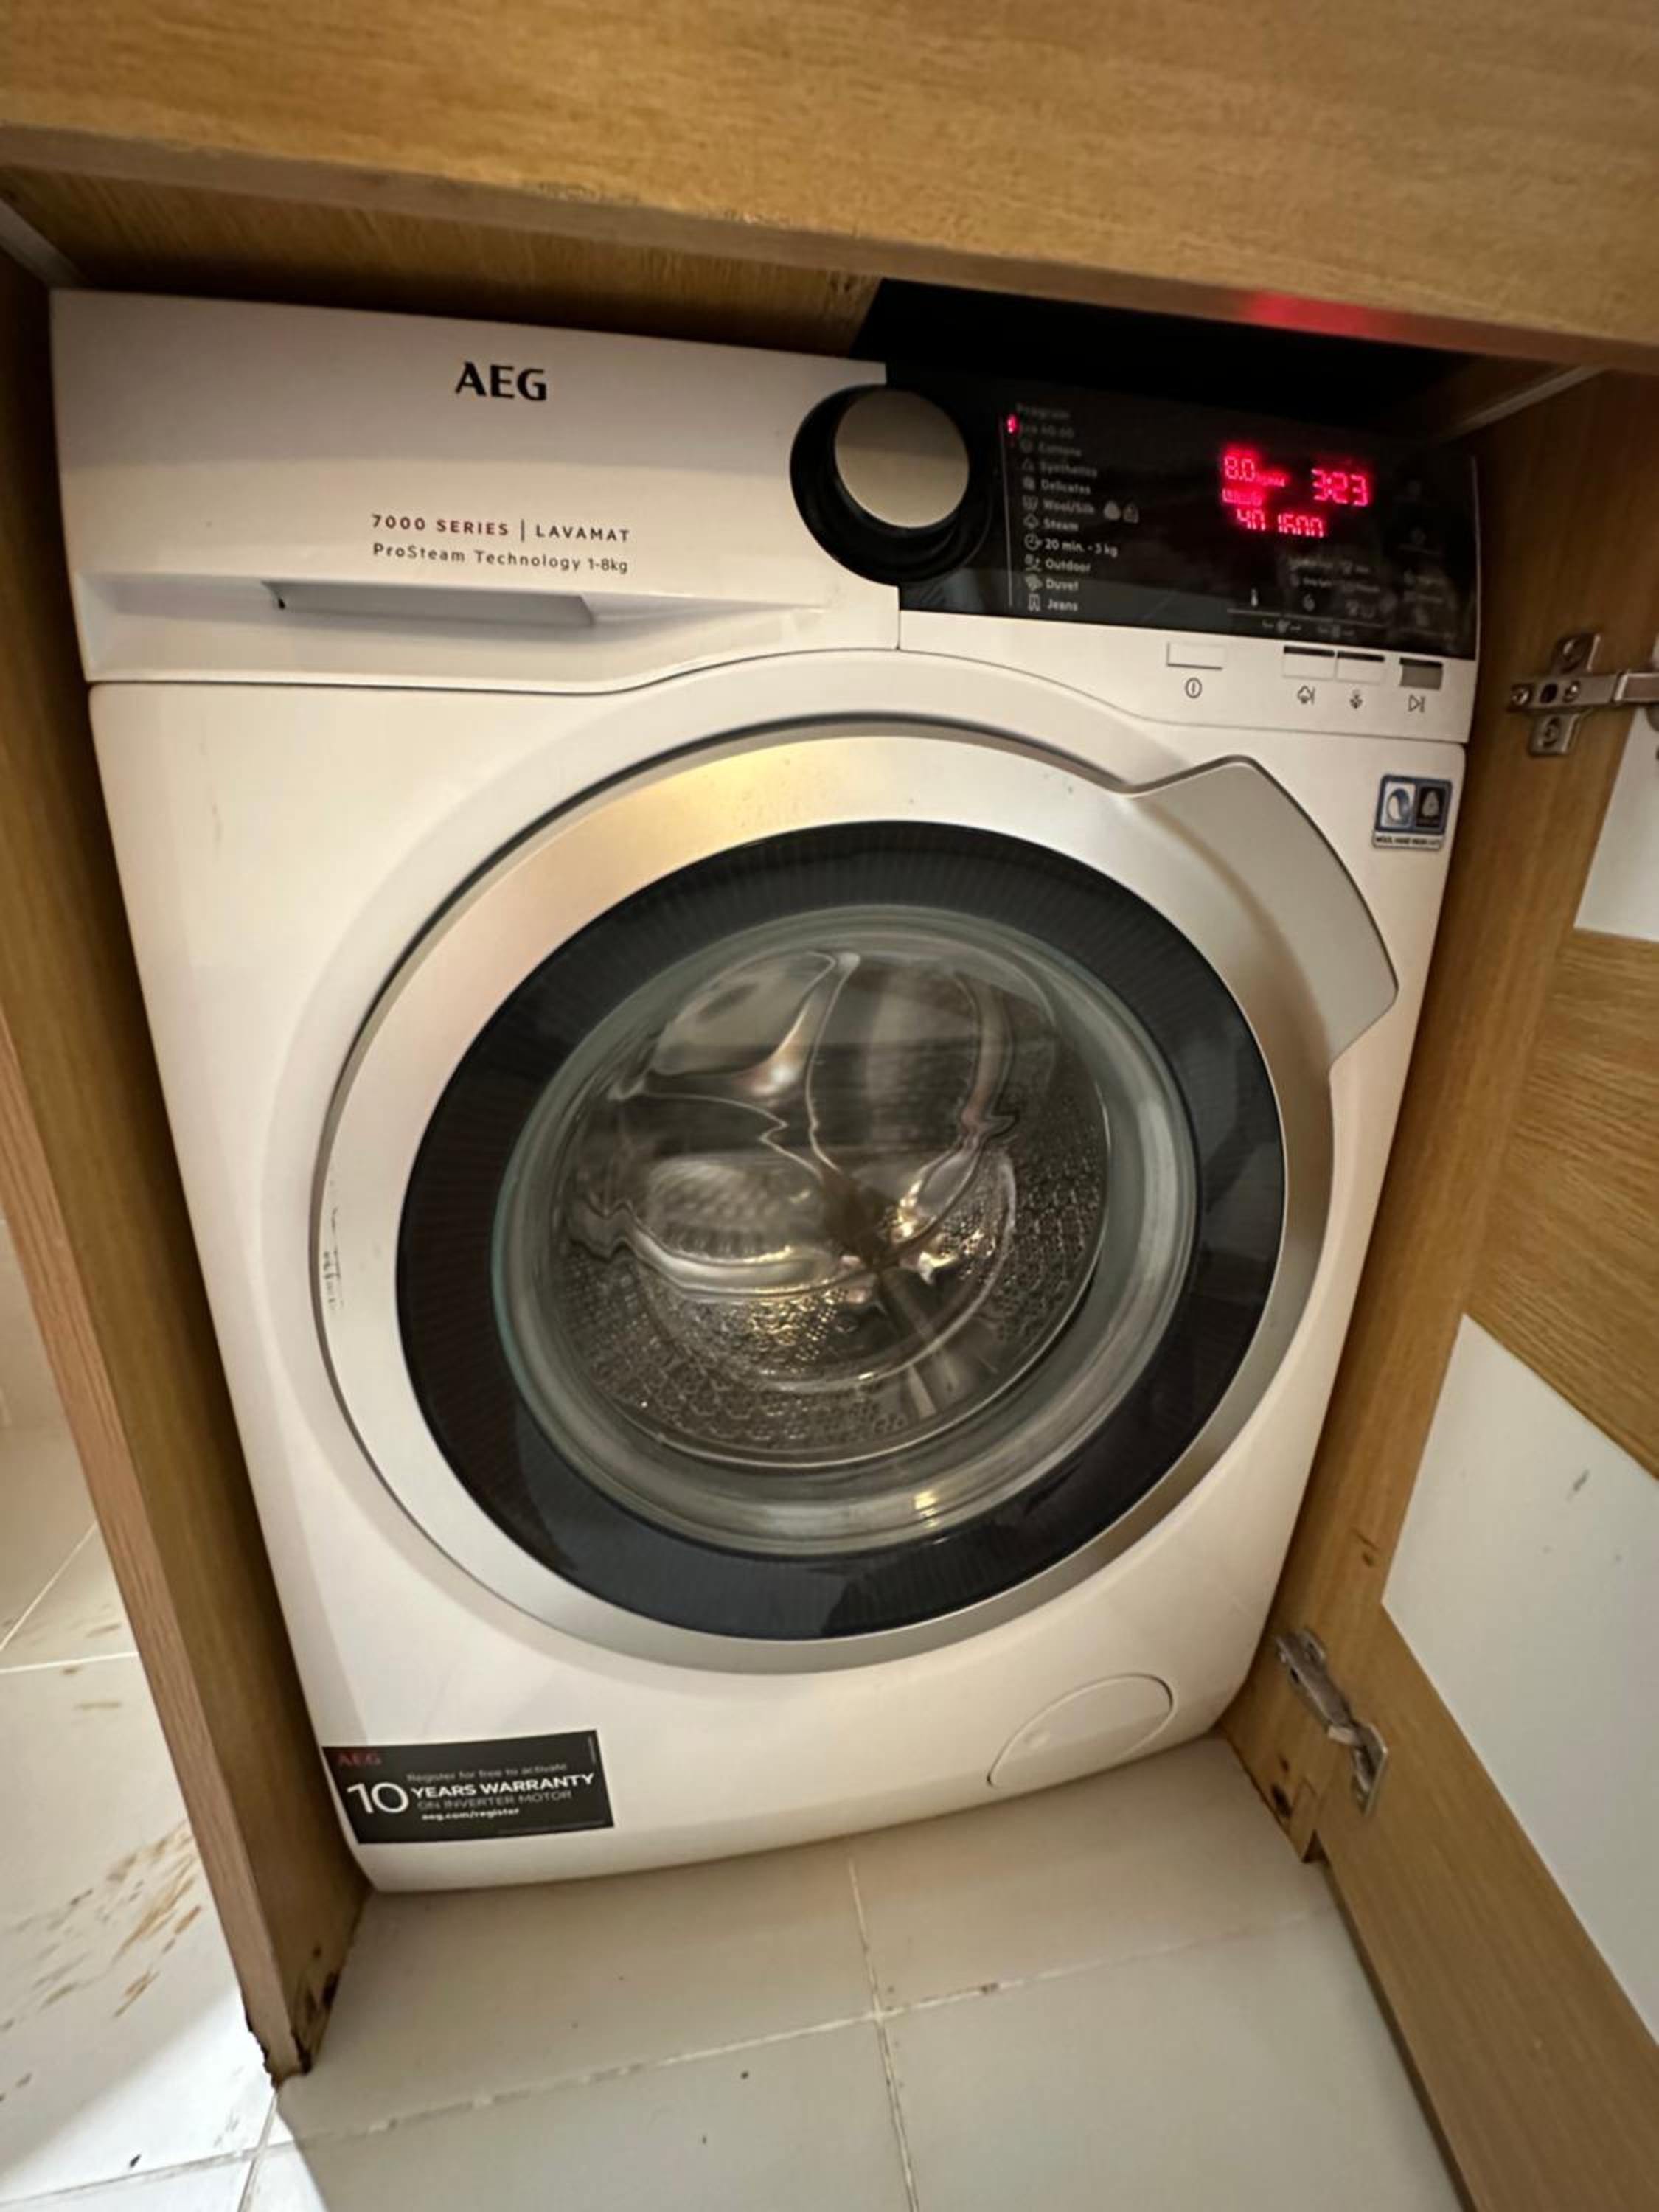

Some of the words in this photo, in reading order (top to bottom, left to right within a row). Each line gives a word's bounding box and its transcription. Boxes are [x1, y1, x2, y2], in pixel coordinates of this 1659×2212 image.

[454, 361, 548, 402] AEG
[1041, 479, 1091, 495] Delicates
[1311, 467, 1369, 507] 3:23
[1043, 498, 1095, 515] Wool/Silk
[371, 515, 426, 530] 7000
[436, 518, 509, 536] SERIES
[535, 524, 630, 542] LAVAMAT
[1043, 518, 1079, 532] Steam
[1044, 538, 1060, 550] 20
[1062, 540, 1085, 552] min.
[1104, 543, 1118, 558] kg
[372, 542, 466, 563] ProSteam
[474, 549, 581, 571] Technology
[588, 557, 629, 574] 1-8kg
[1045, 557, 1091, 572] Outdoor
[1046, 574, 1079, 591] Duvet
[1047, 594, 1079, 611] Jeans
[338, 1752, 382, 1767] AEG
[406, 1771, 456, 1784] Register
[459, 1770, 476, 1780] for
[478, 1768, 503, 1779] free
[505, 1767, 519, 1777] to
[521, 1762, 568, 1775] activate
[346, 1781, 410, 1814] 10
[410, 1783, 477, 1799] YEARS
[480, 1773, 595, 1795] WARRANTY
[417, 1799, 442, 1811] ON
[444, 1794, 515, 1809] INVERTER
[518, 1790, 572, 1804] MOTOR
[421, 1807, 520, 1822] aeg.com/register
